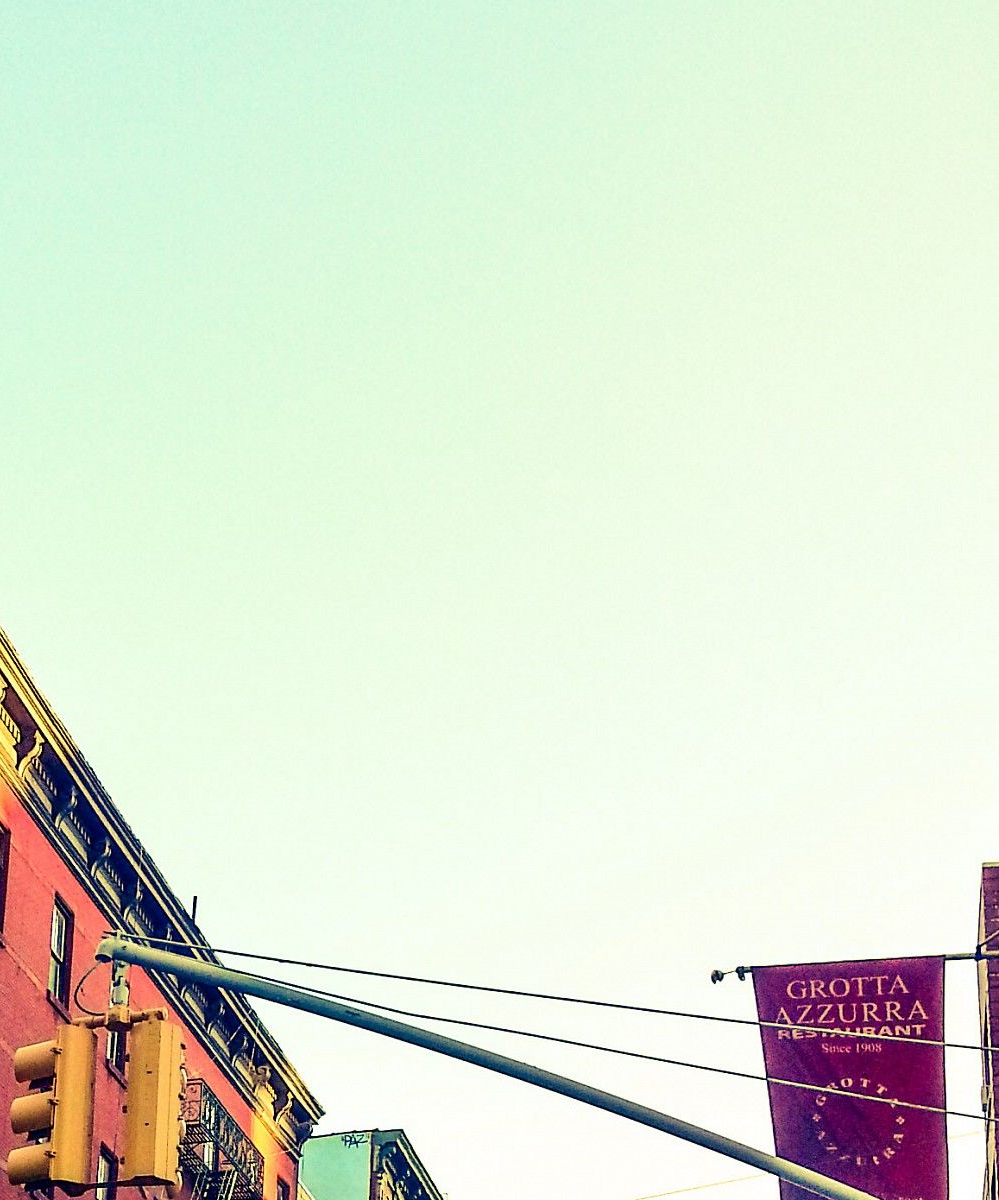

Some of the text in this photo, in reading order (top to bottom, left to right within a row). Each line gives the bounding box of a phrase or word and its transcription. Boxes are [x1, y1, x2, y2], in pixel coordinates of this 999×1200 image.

[786, 975, 910, 999] GROTTA
[776, 1000, 929, 1025] AZZURRA
[777, 1024, 927, 1040] RESTAURANT
[821, 1042, 883, 1054] Since 1908
